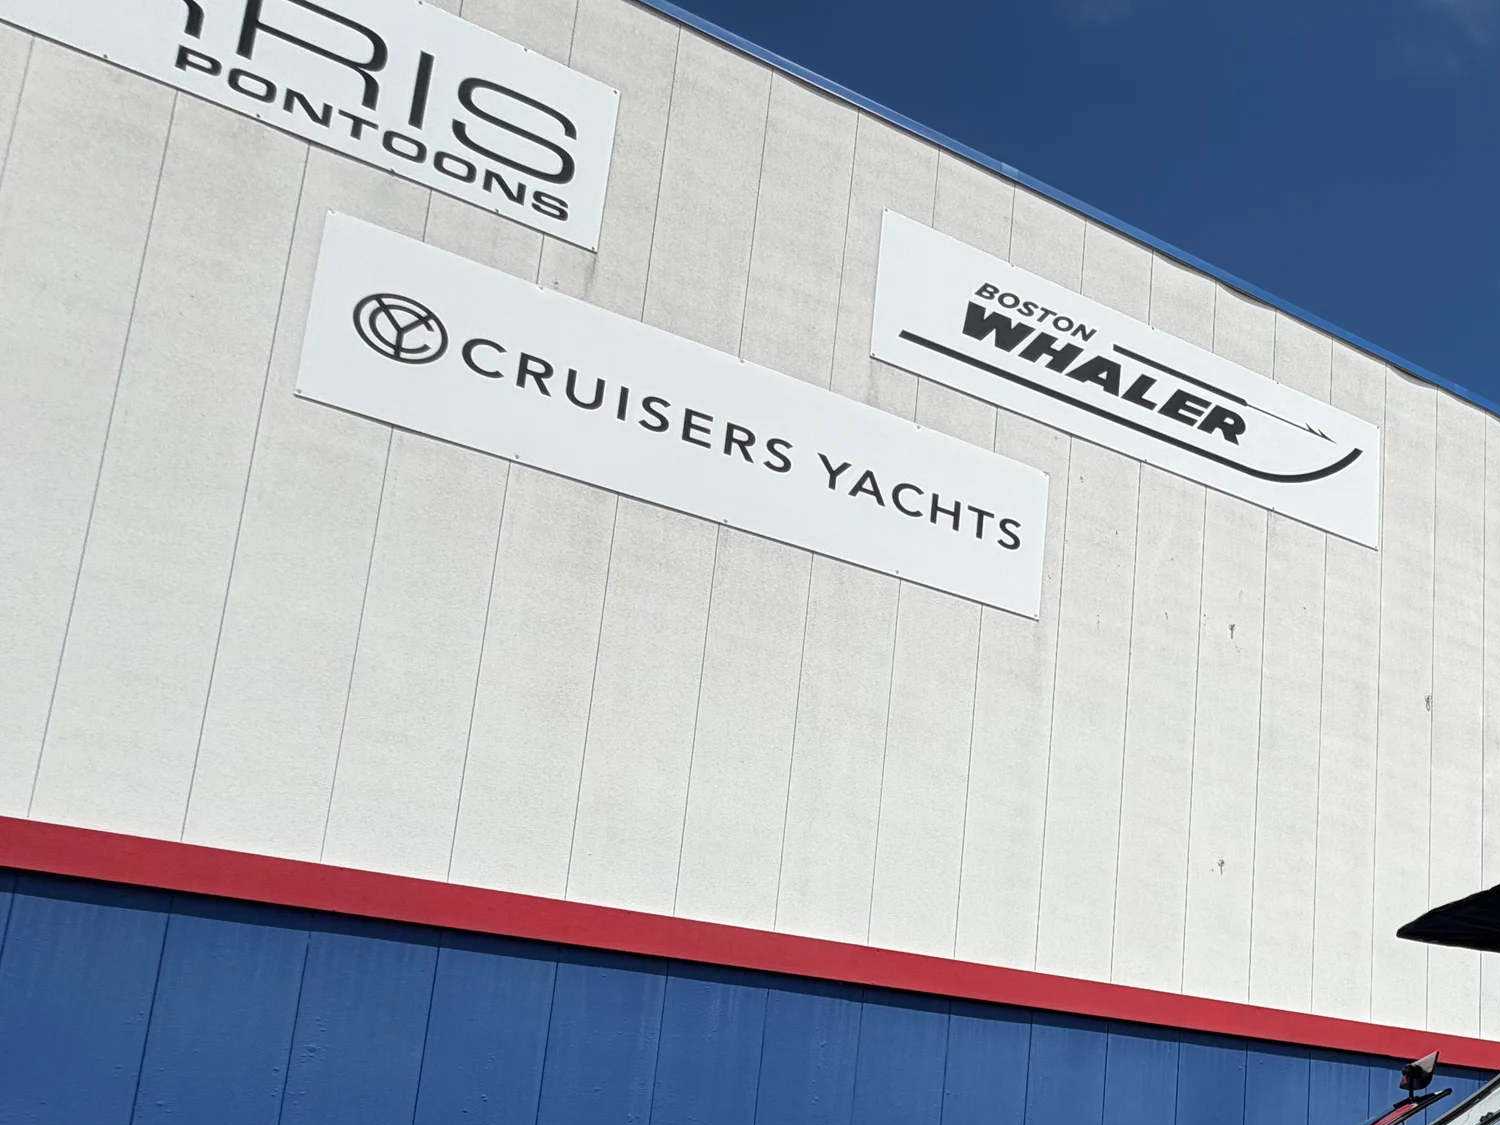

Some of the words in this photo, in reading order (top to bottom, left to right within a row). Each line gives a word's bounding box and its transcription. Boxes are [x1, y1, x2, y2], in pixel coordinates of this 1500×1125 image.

[174, 44, 570, 222] PONTOONS
[182, 0, 578, 185] RIS
[962, 300, 1246, 446] WHALER
[974, 282, 1097, 342] BOSTON
[461, 338, 793, 473] CRUISERS
[817, 452, 1021, 550] YACHTS
